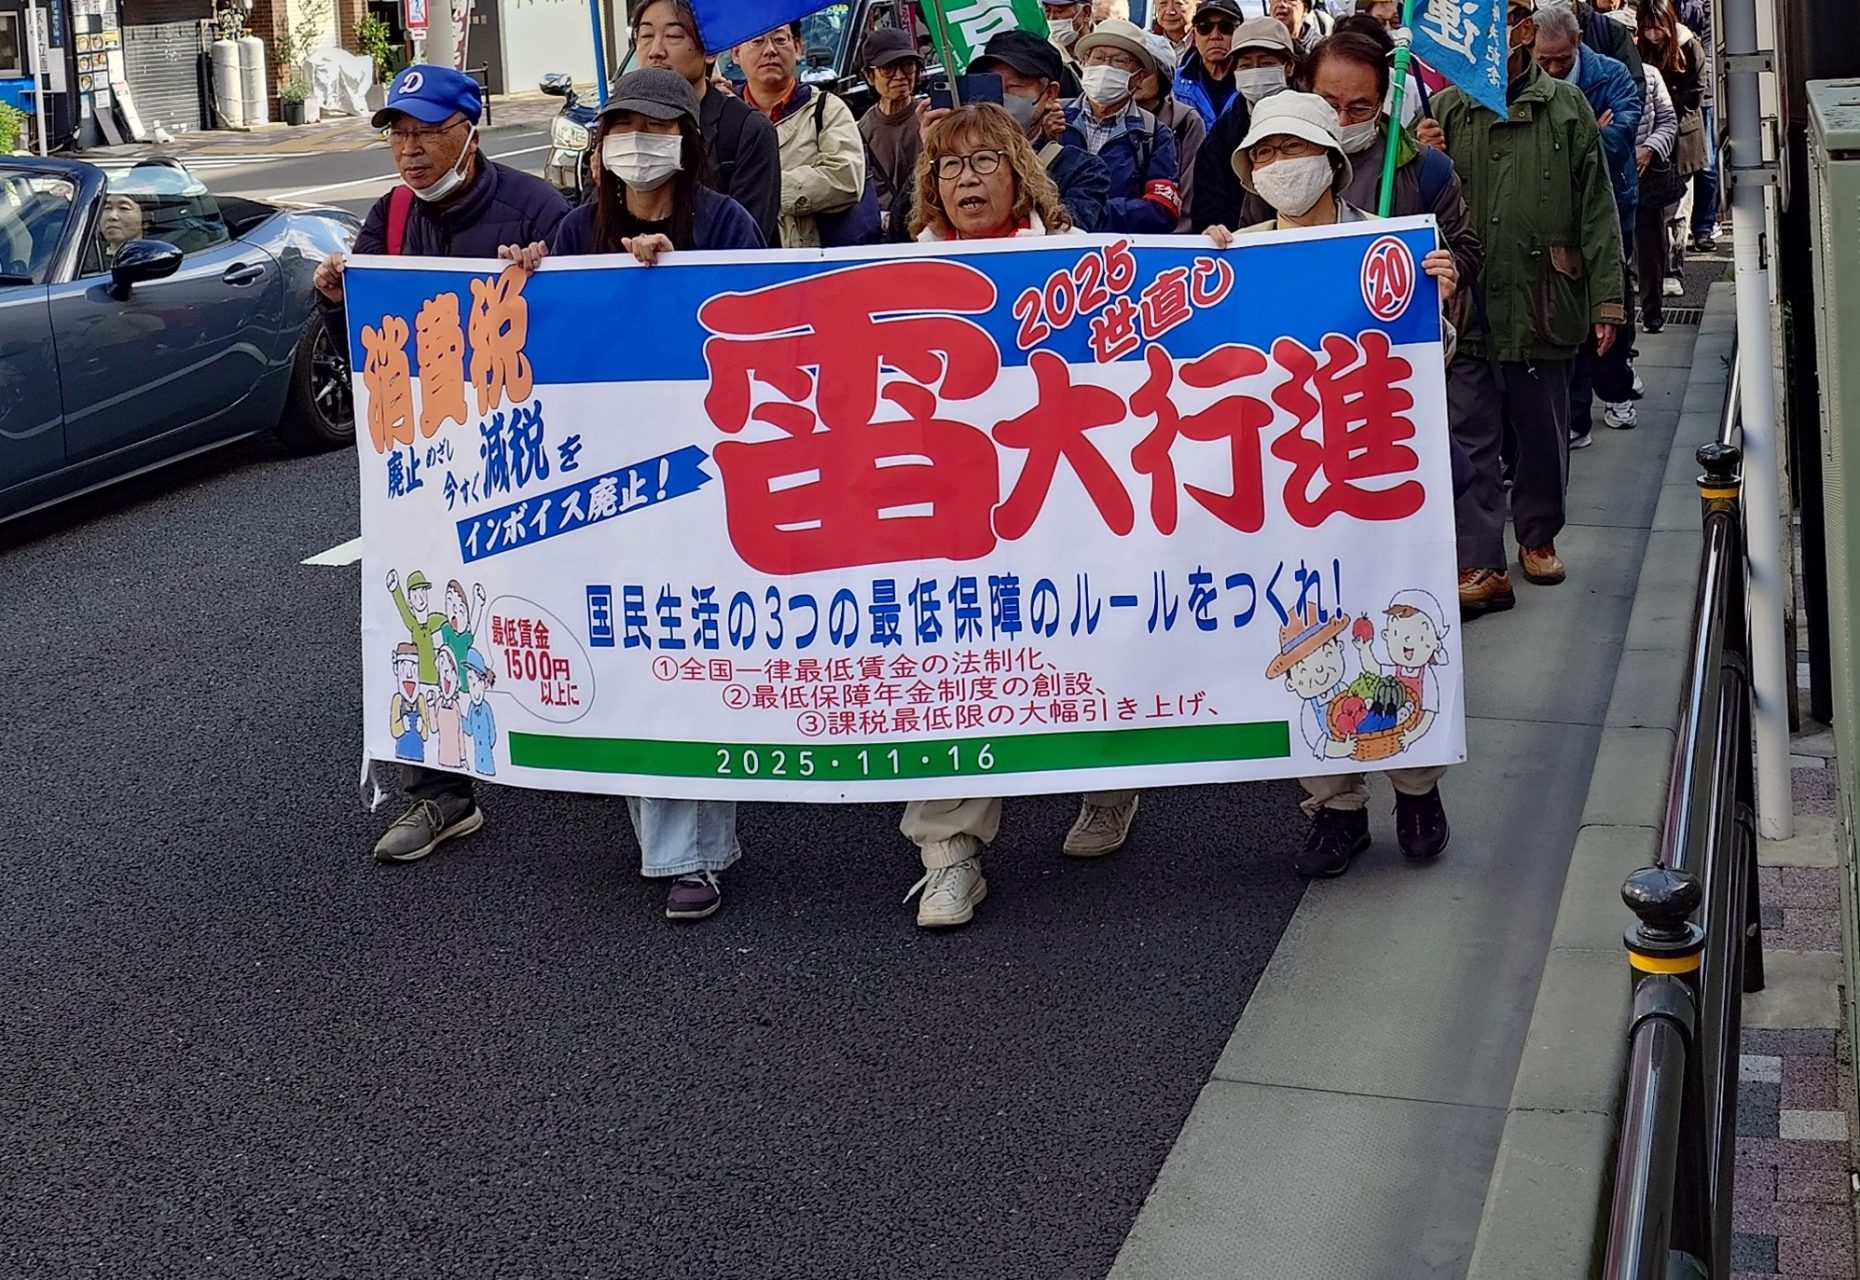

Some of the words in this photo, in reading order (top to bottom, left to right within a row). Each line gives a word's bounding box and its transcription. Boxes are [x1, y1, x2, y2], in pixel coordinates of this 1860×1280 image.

[399, 71, 424, 94] D
[1011, 239, 1137, 350] 2025
[1089, 255, 1235, 363] 世直し
[361, 265, 534, 454] 消費税
[491, 614, 551, 648] 最低賃金
[504, 649, 572, 682] 1500円
[540, 677, 581, 708] 以上に
